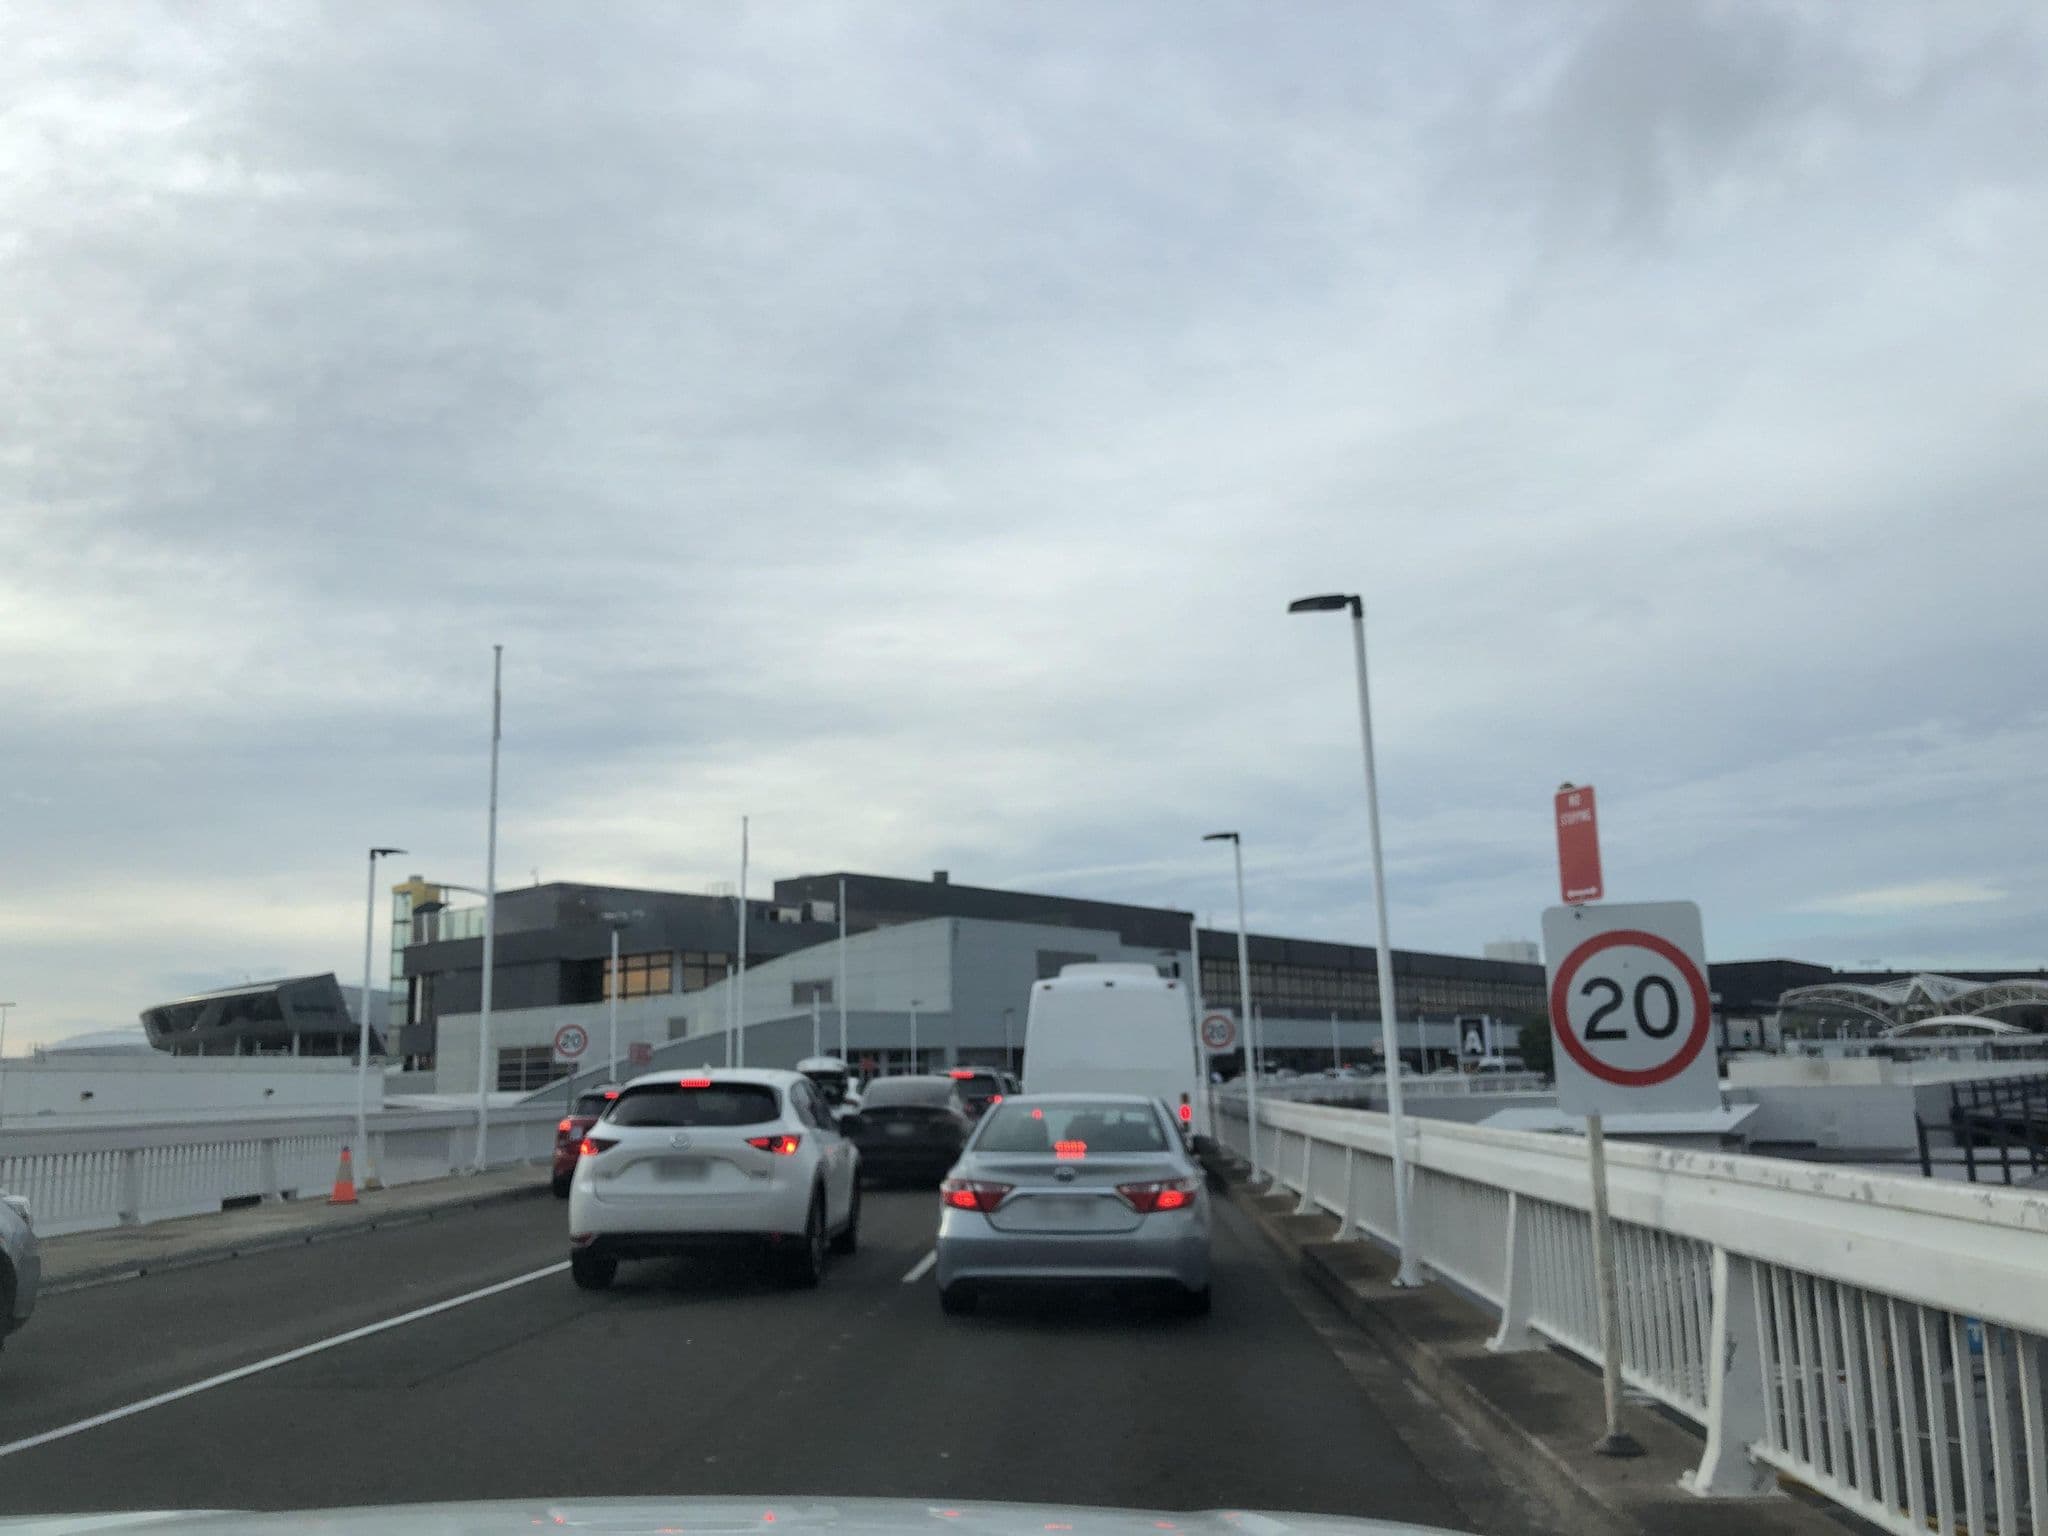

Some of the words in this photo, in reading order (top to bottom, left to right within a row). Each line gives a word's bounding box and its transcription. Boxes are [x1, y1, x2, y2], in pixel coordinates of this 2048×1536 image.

[1581, 975, 1679, 1041] 20
[1208, 1023, 1227, 1040] 20
[560, 1033, 582, 1048] 20
